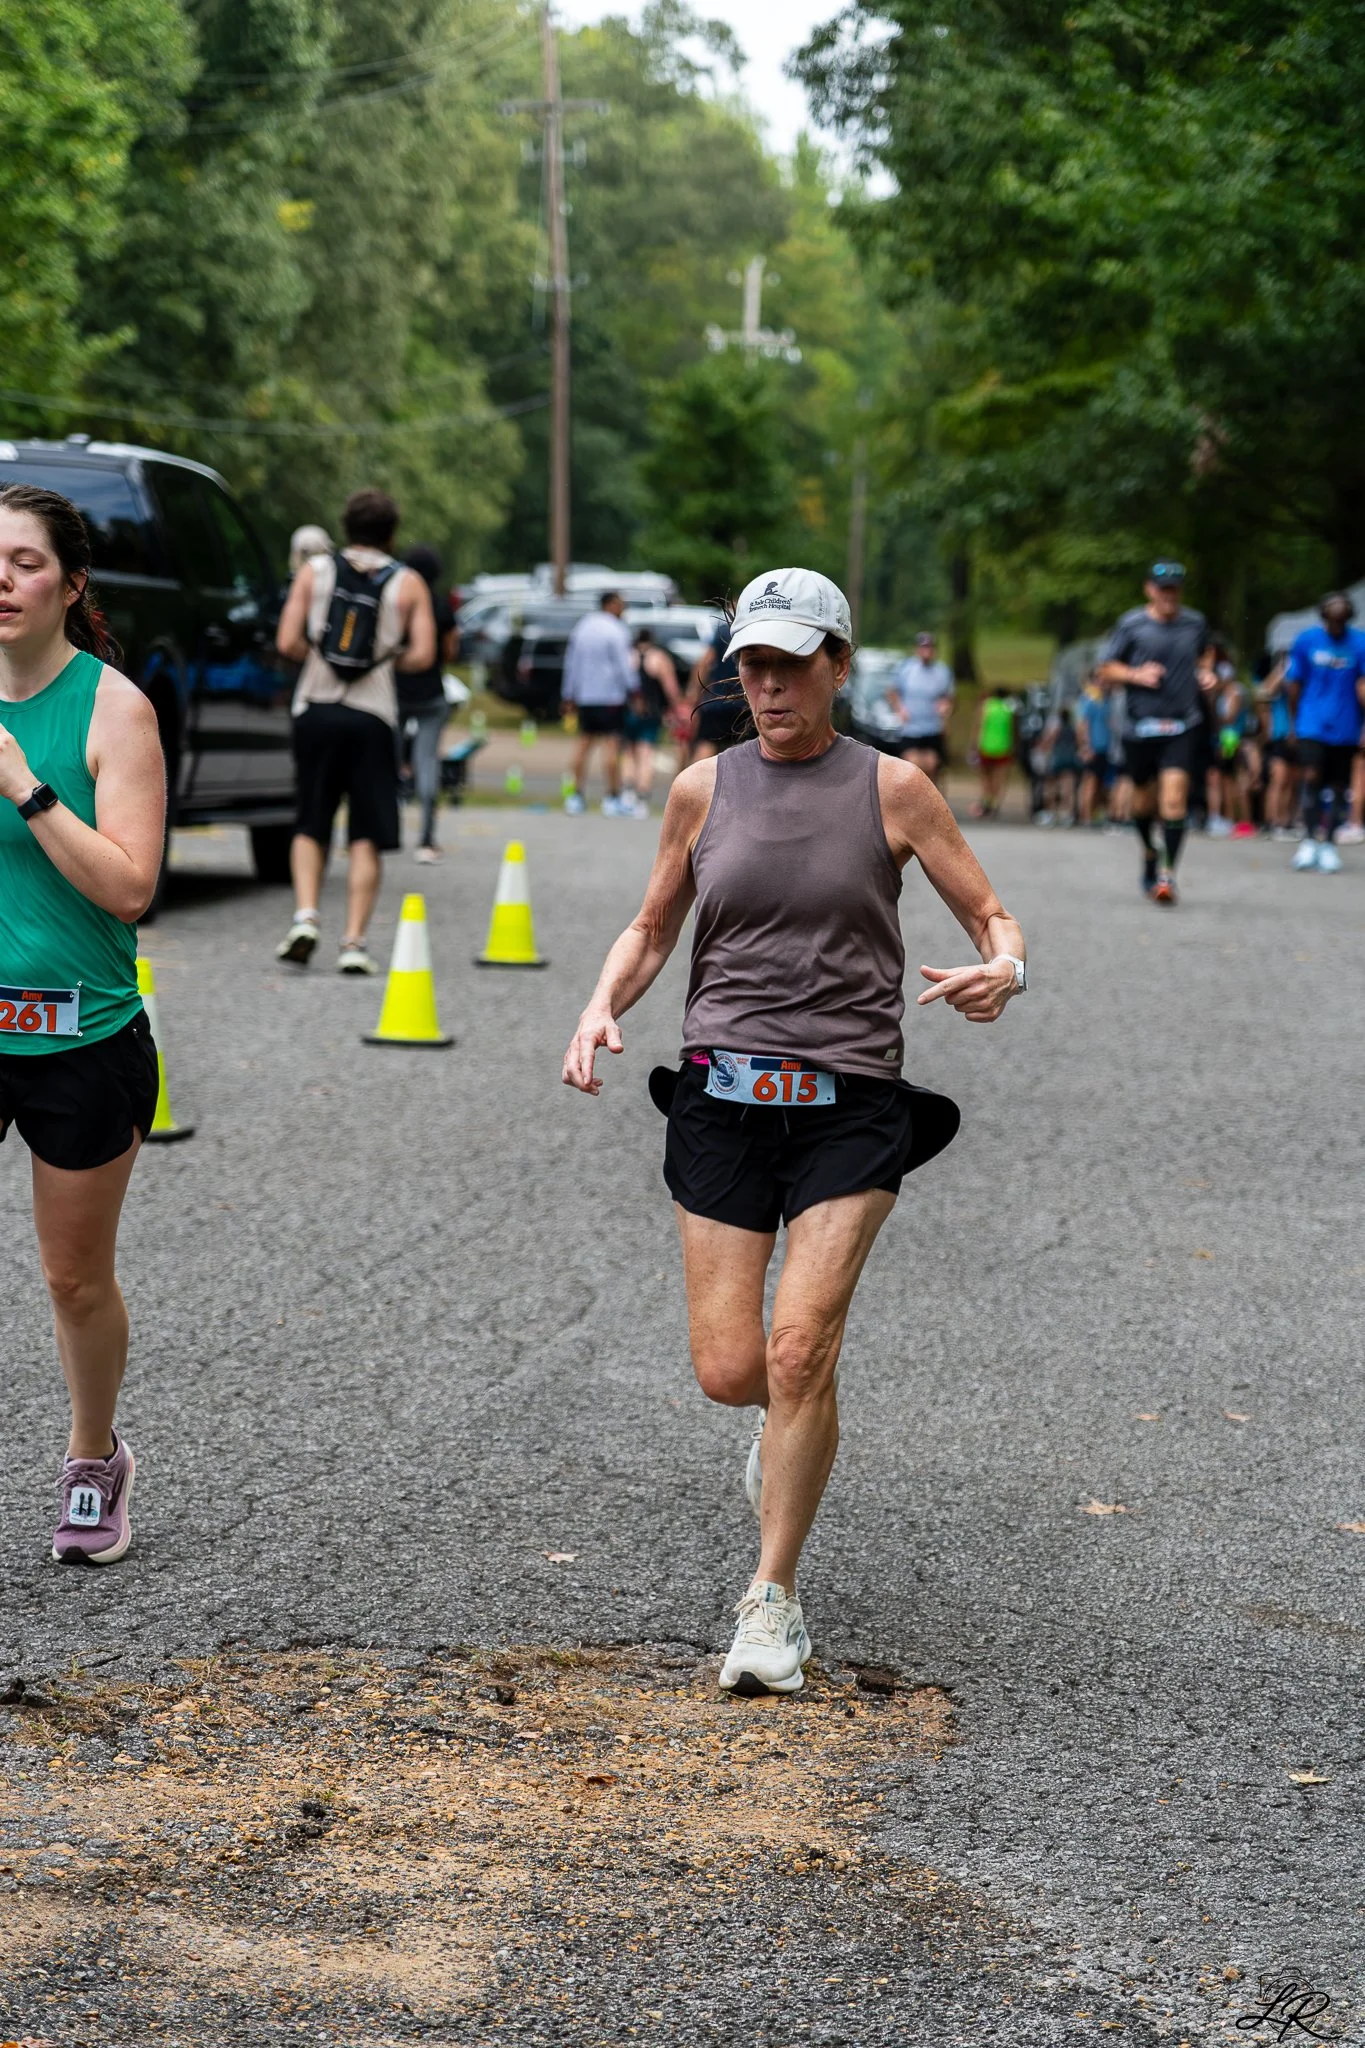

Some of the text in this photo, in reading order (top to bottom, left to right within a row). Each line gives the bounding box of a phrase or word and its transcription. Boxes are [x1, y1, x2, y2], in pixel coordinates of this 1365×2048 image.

[768, 603, 791, 611] Hospital
[21, 991, 43, 1002] Amy
[0, 1001, 58, 1033] 261
[780, 1060, 802, 1072] Amy
[752, 1072, 818, 1103] 615
